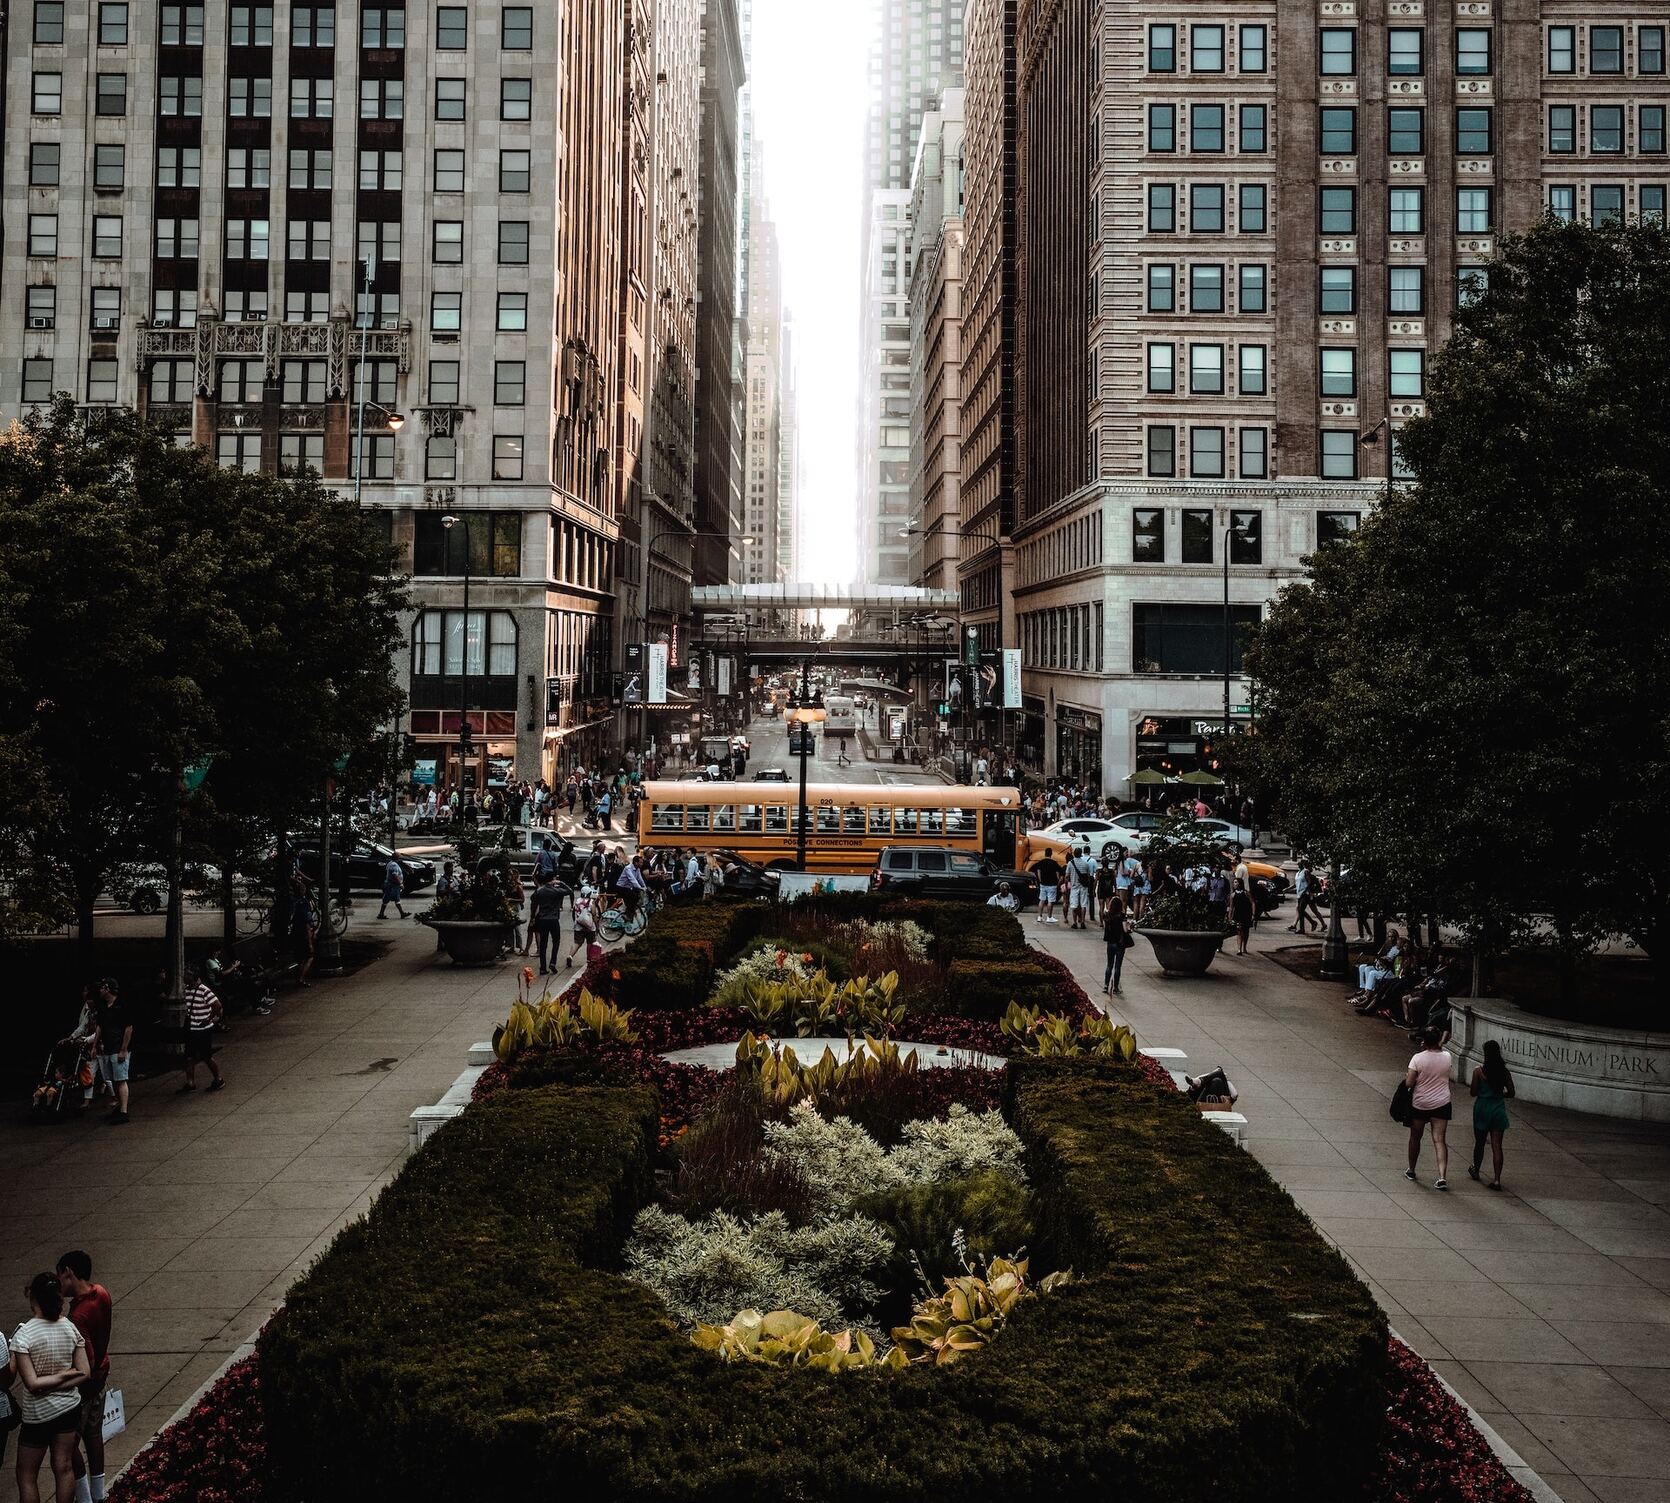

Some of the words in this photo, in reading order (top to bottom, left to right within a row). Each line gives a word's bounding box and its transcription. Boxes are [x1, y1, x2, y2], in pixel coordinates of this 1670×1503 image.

[816, 839, 863, 847] CONNECTIONS
[1500, 1037, 1593, 1067] MILLENNIUM
[1609, 1054, 1658, 1074] PARK
